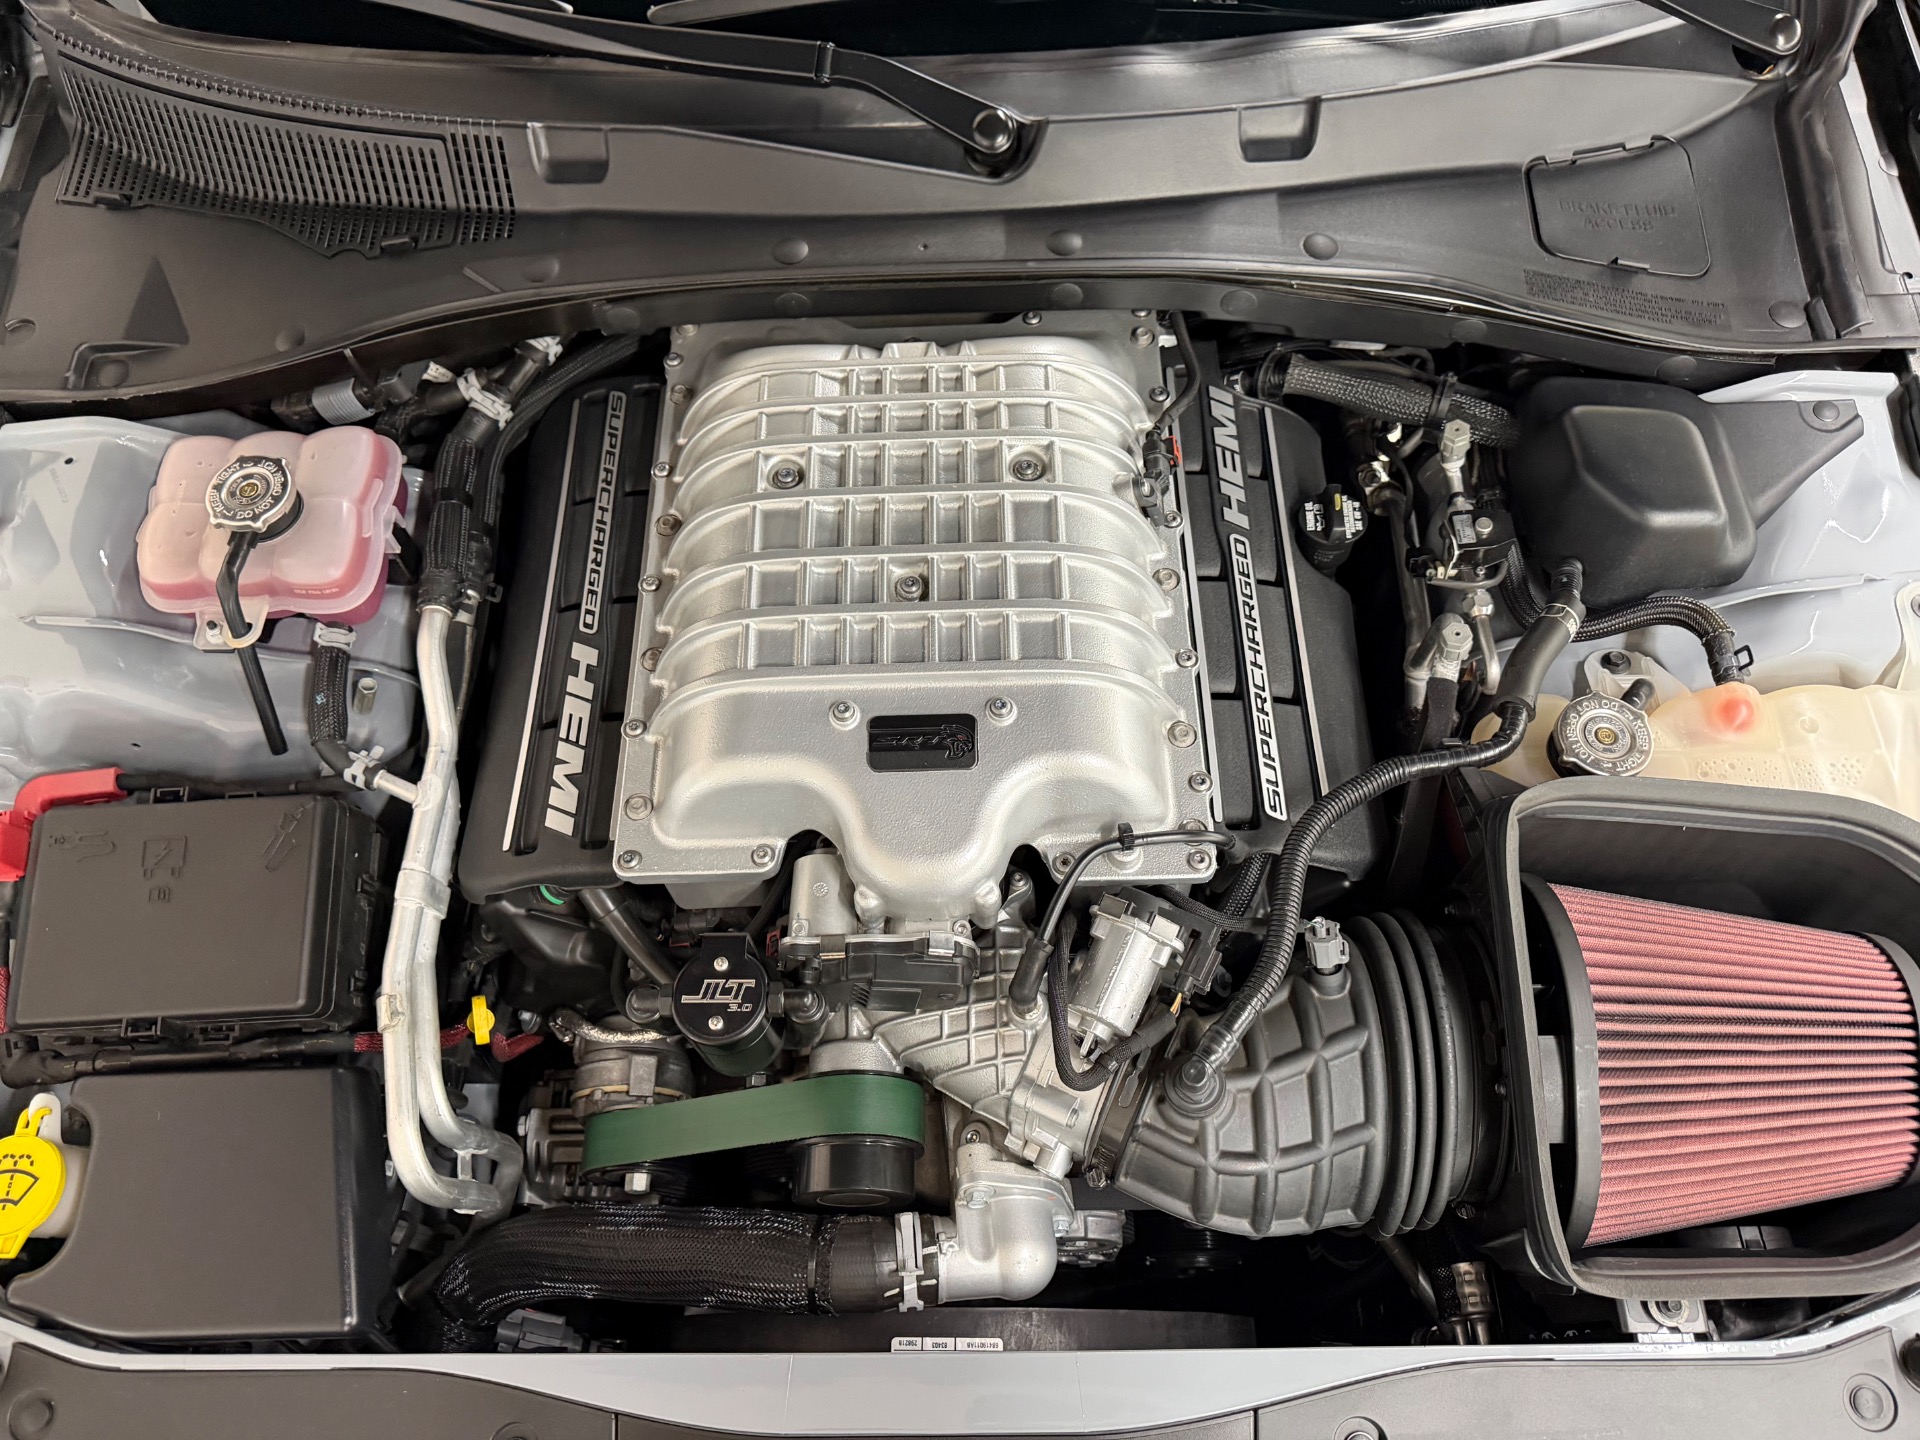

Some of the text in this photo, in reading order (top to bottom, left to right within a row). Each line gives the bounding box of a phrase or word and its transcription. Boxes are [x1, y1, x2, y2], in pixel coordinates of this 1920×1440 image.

[209, 461, 240, 513] KEEP TIGHT
[235, 510, 253, 519] DO
[254, 496, 275, 514] NOT
[544, 391, 625, 837] SUPERCHARGED HEMI
[1208, 385, 1286, 819] SUPERCHARGED HEMI
[1576, 699, 1600, 715] NOT
[1601, 699, 1619, 712] DO
[1566, 713, 1579, 741] OPEN
[1571, 742, 1596, 763] HOT
[1615, 719, 1649, 772] KEEP TIGHT
[681, 979, 756, 1003] JLT
[727, 1003, 753, 1012] 3.0
